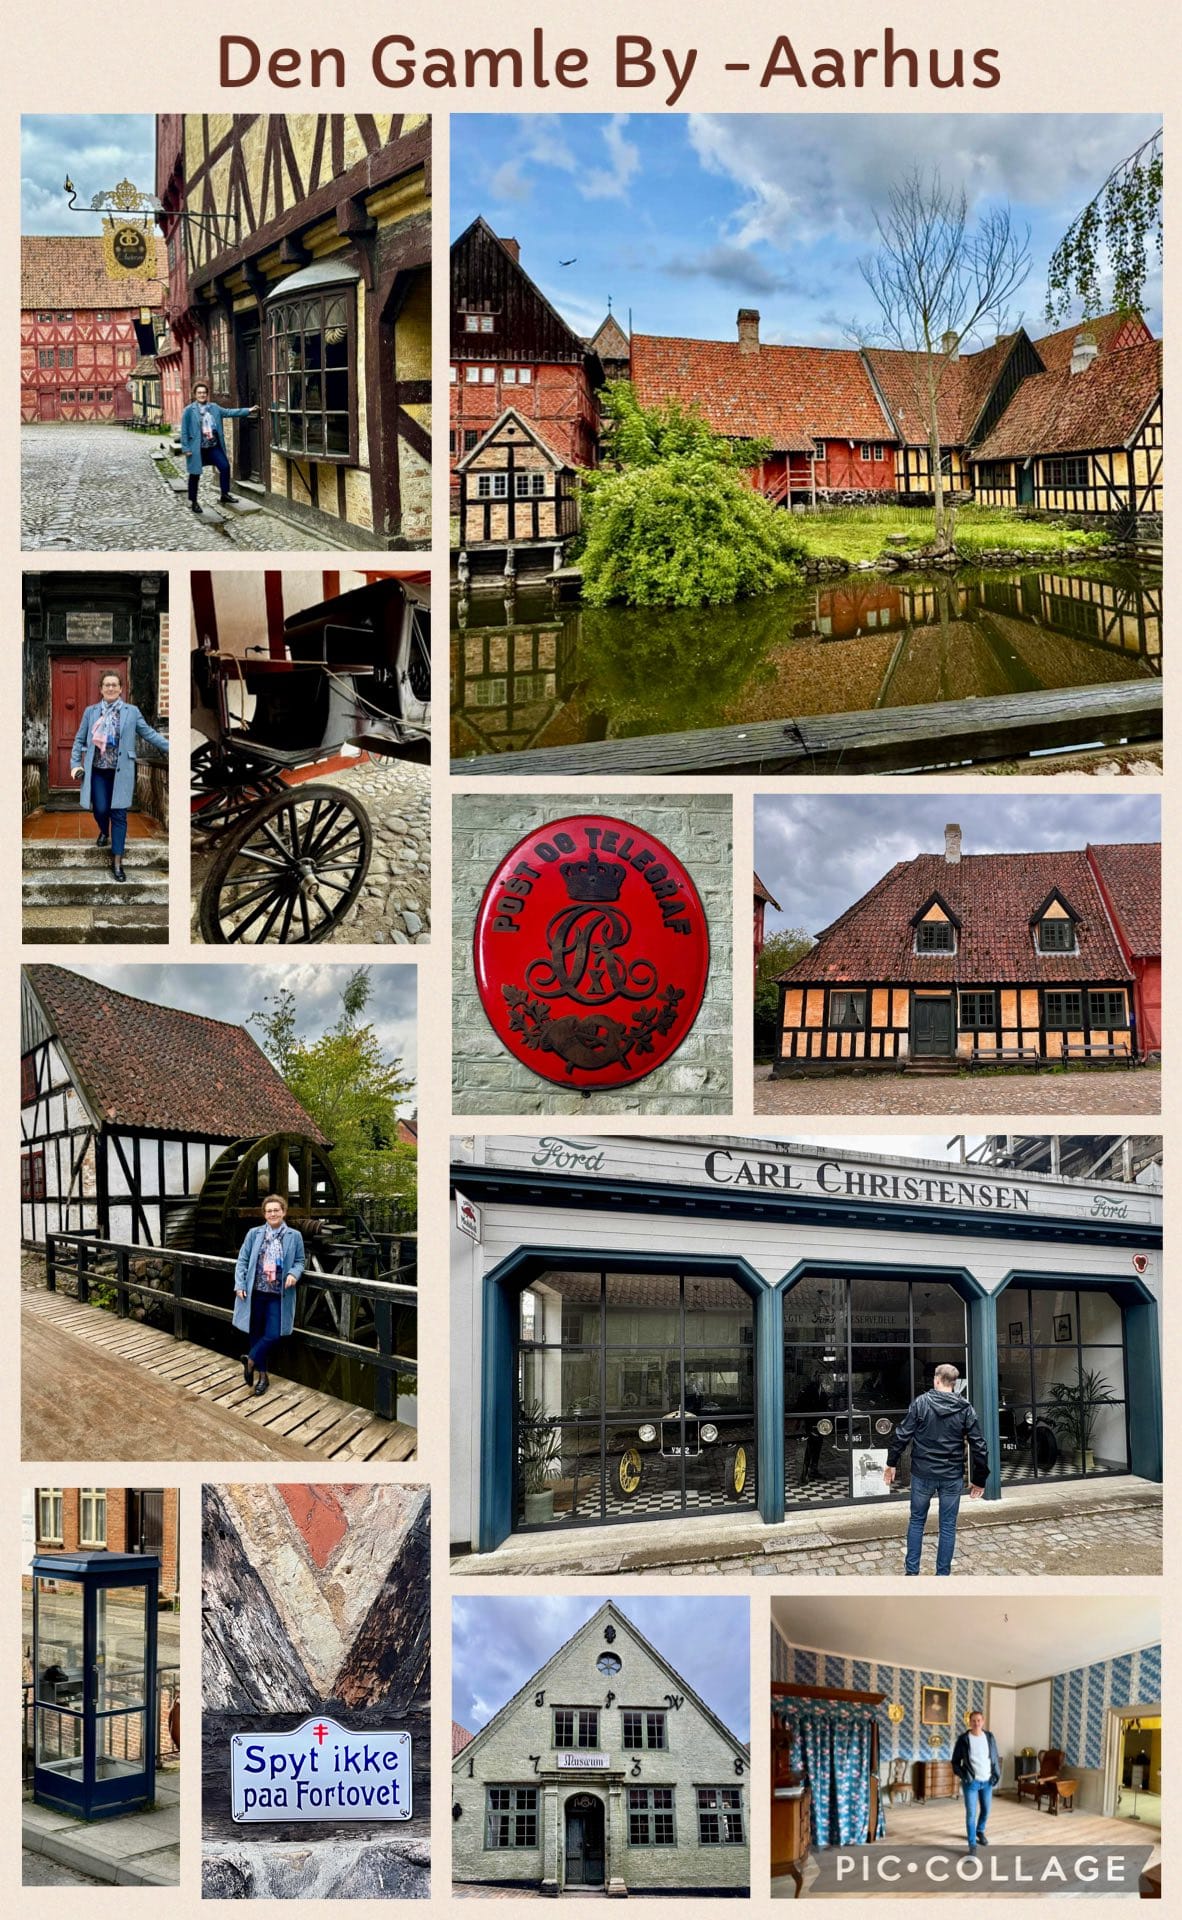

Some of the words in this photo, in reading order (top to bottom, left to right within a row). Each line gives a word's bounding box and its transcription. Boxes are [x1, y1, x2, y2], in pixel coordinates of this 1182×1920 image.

[492, 861, 541, 932] POST
[584, 828, 691, 936] TELEGRAF
[531, 1136, 605, 1171] Ford
[704, 1150, 802, 1190] CARL
[816, 1162, 1029, 1210] CHRISTENSEN
[1090, 1195, 1128, 1219] Ford
[243, 1745, 319, 1780] Spyt
[334, 1744, 399, 1774] ikke
[631, 1757, 641, 1777] 3
[734, 1758, 744, 1776] 8
[243, 1787, 288, 1812] paa
[296, 1779, 400, 1811] Fortovet
